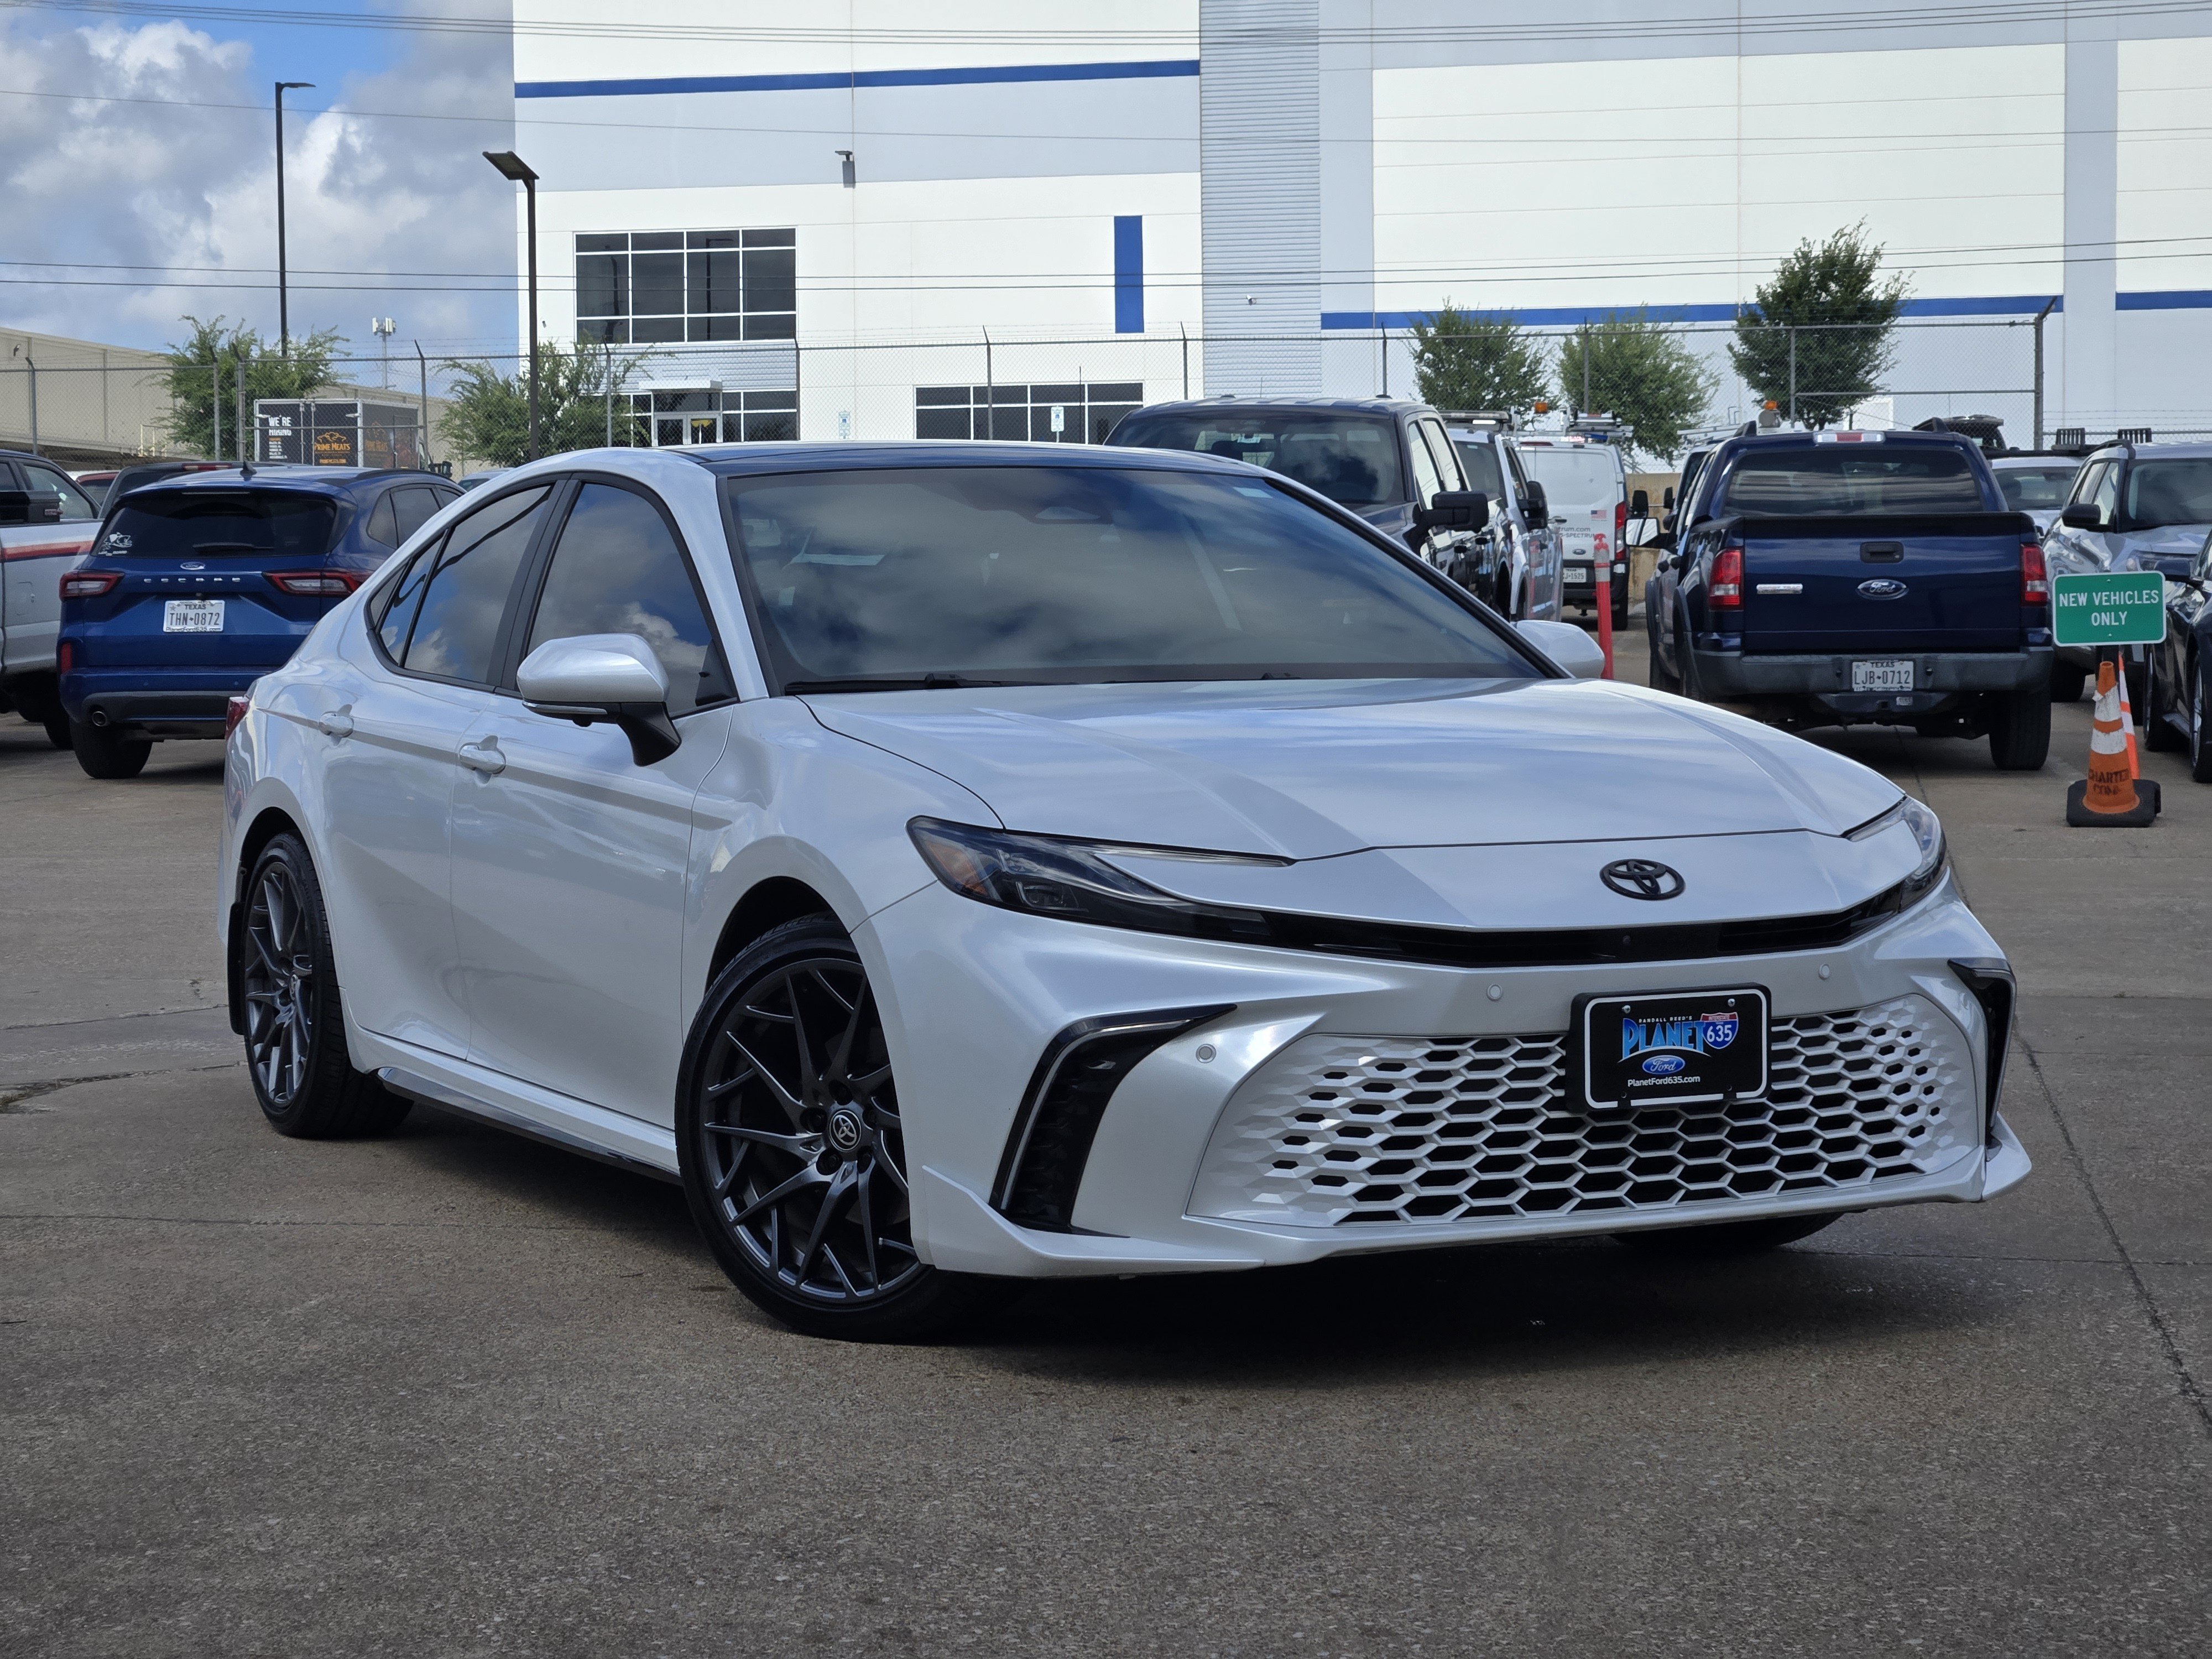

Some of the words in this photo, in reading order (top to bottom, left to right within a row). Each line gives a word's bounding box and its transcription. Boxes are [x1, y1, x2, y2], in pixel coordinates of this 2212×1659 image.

[268, 415, 292, 426] WE'RE
[331, 442, 351, 451] MEATS
[1869, 581, 1896, 593] Ford
[2059, 592, 2088, 607] NEW
[2093, 590, 2159, 606] VEHICLES
[2091, 611, 2128, 627] ONLY
[1623, 1018, 1705, 1061] PLANET
[1707, 1024, 1733, 1042] 635
[1650, 1056, 1677, 1072] Ford
[1627, 1076, 1701, 1088] PlanetFord635.com
